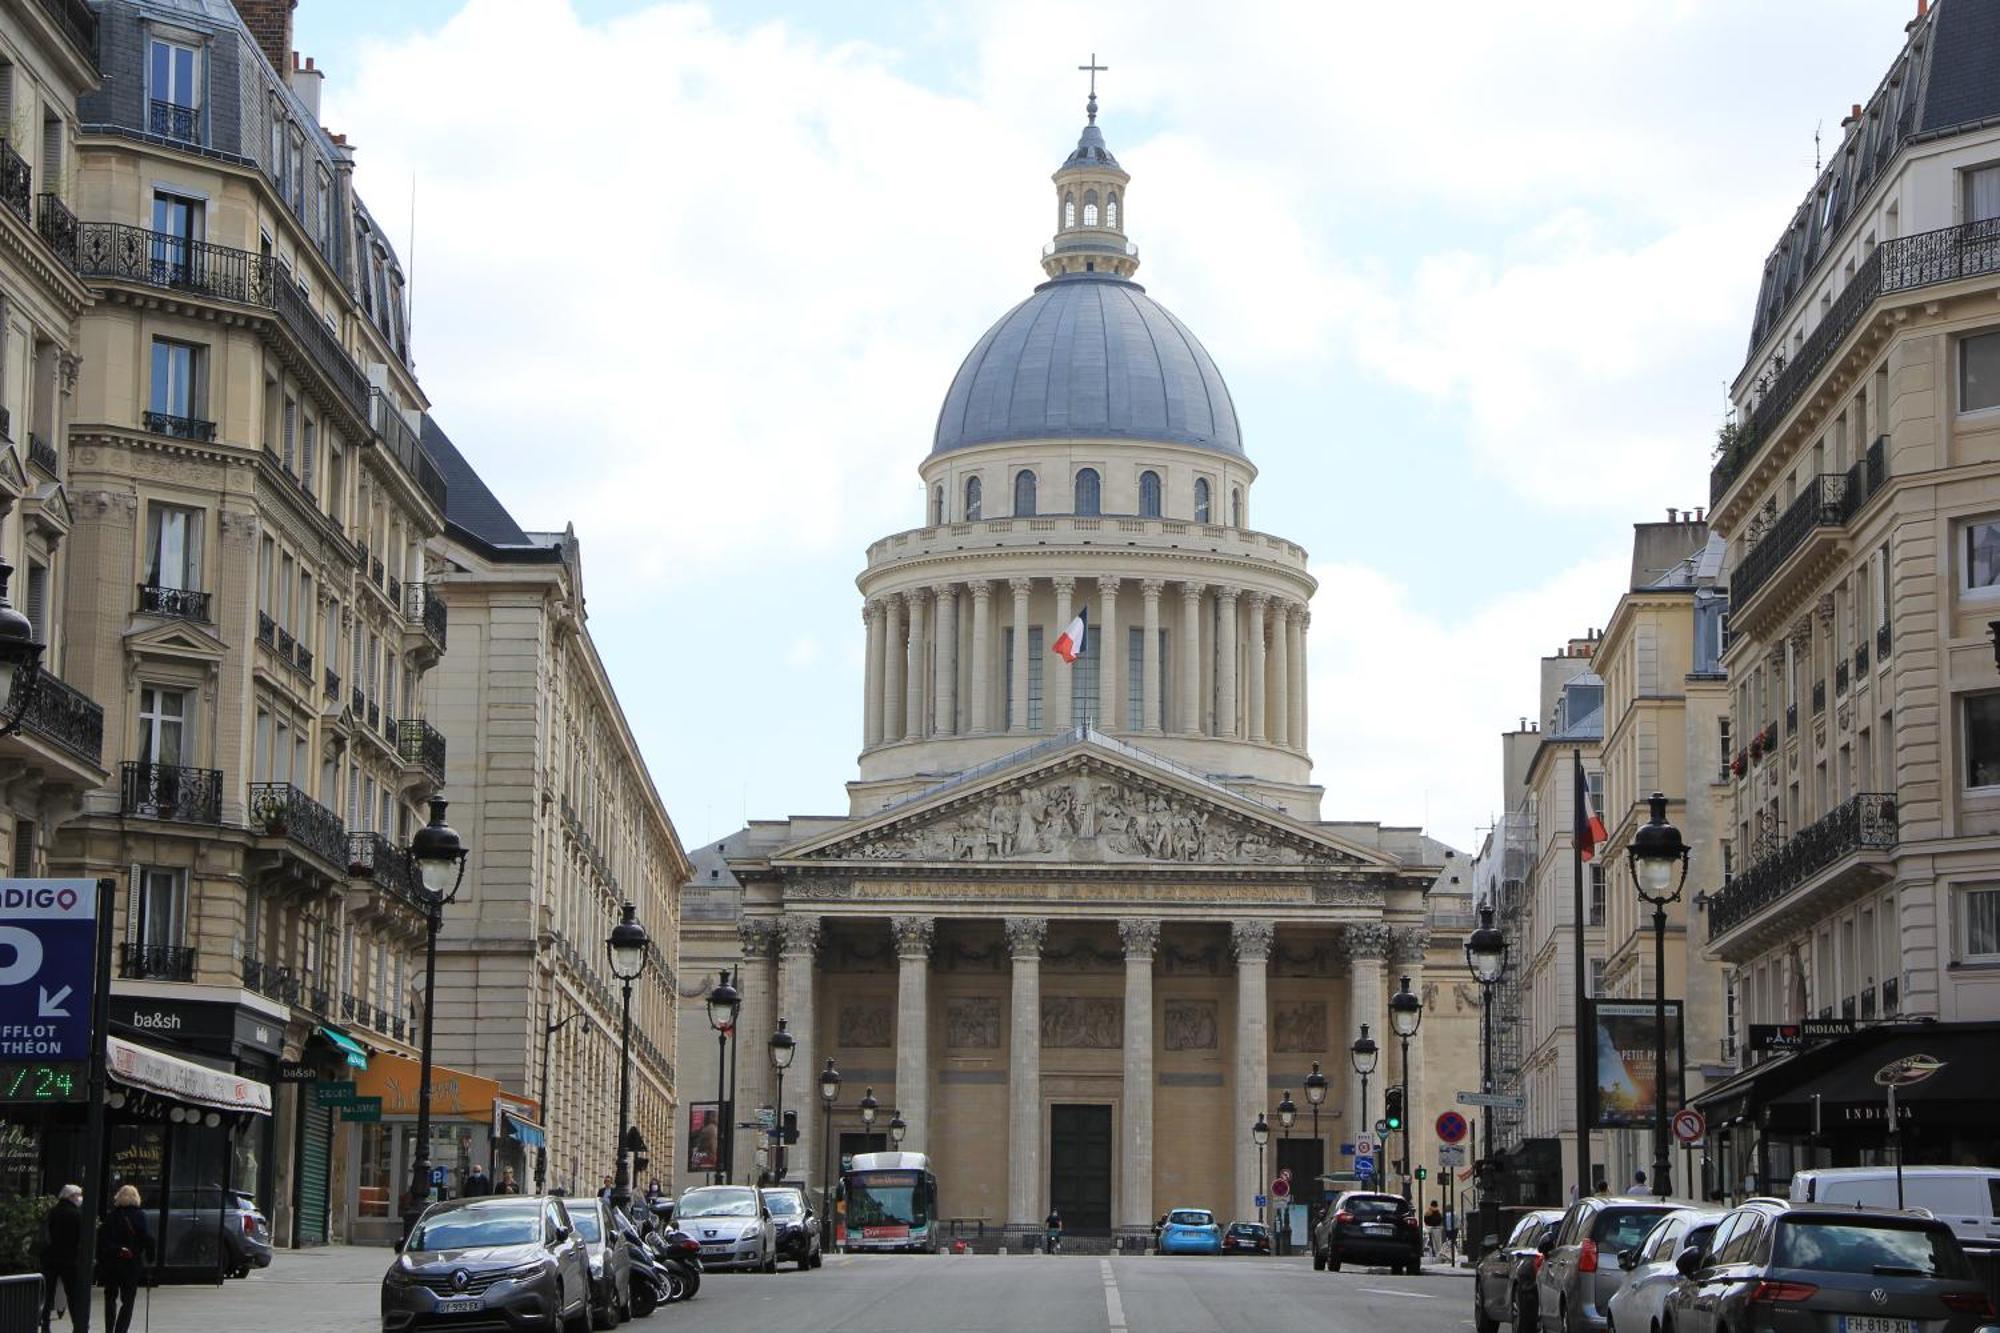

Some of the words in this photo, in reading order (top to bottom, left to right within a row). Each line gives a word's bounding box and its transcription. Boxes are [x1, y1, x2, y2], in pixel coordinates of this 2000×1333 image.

[0, 888, 77, 911] DIGO
[134, 1011, 181, 1029] ba&sh
[0, 1025, 57, 1038] FFLOT
[1804, 1024, 1851, 1035] INDIANA
[1, 1039, 62, 1054] THÉON
[283, 1067, 317, 1078] ba&sh
[1847, 1317, 1909, 1333] FH-819-XH
